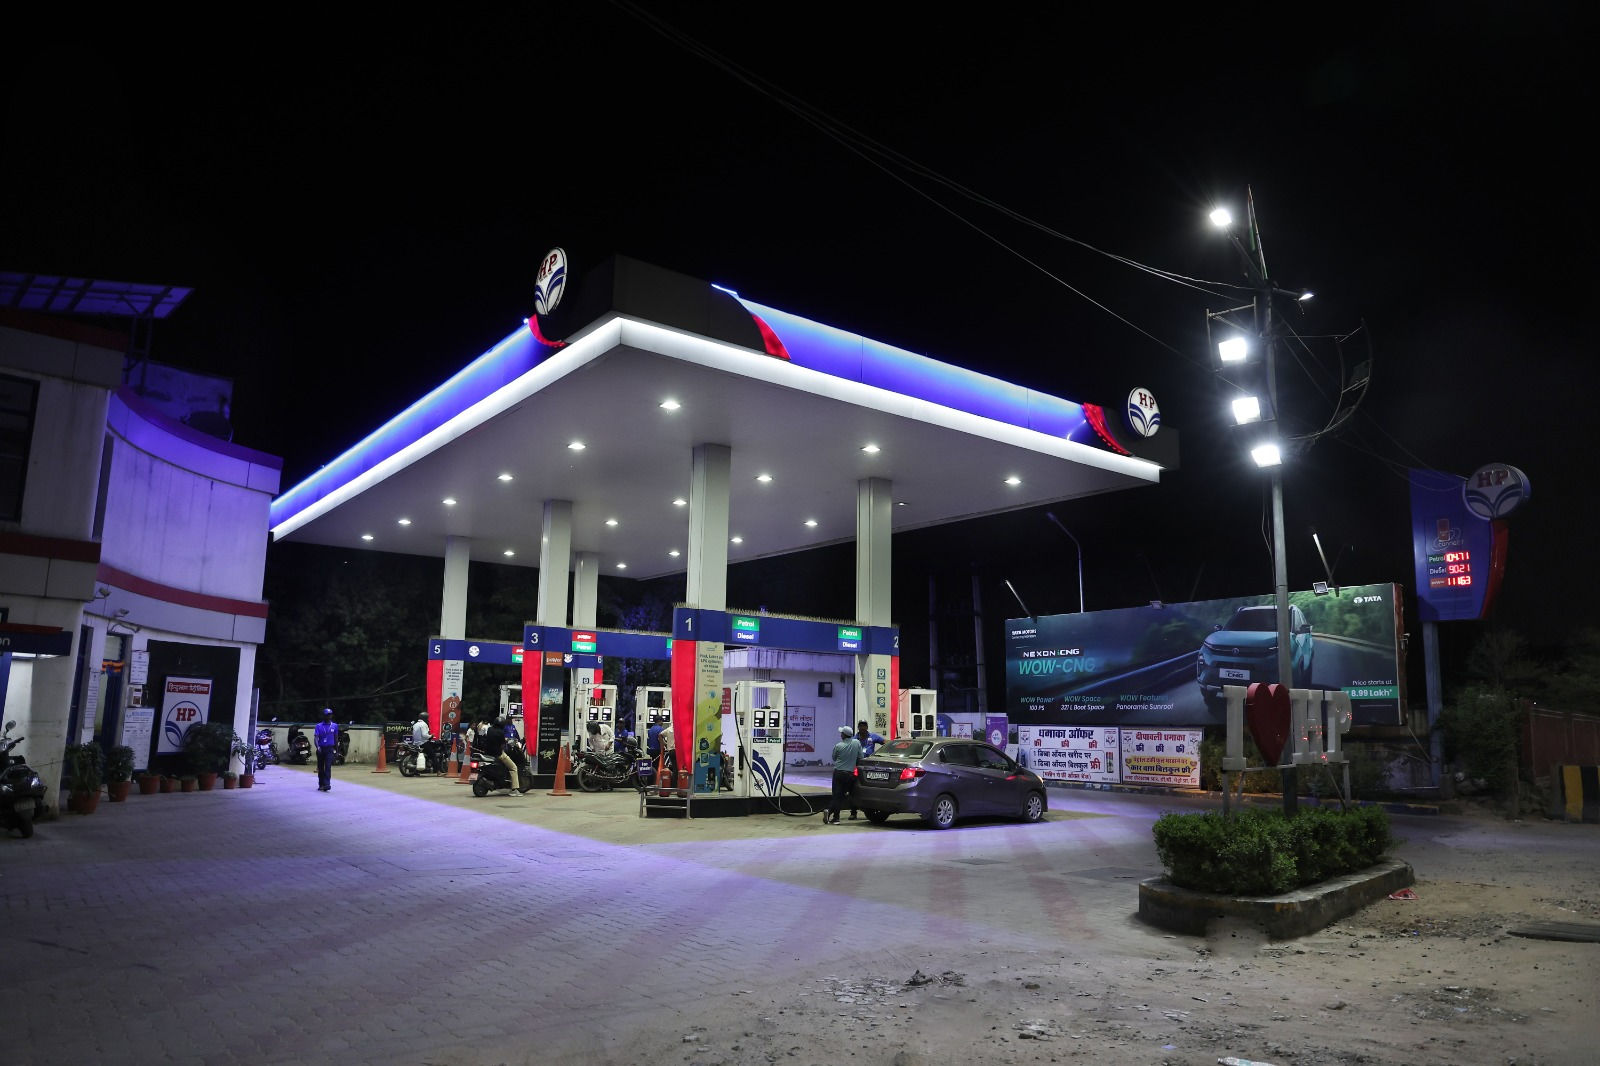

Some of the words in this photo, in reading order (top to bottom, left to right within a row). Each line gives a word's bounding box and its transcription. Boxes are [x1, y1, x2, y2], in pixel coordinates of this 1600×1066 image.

[538, 253, 557, 280] HP
[1138, 391, 1155, 409] HP
[1477, 469, 1509, 488] HP
[1363, 595, 1382, 603] TATA
[685, 617, 692, 632] 1
[737, 619, 755, 627] Petrol
[530, 632, 539, 644] 3
[737, 632, 755, 640] Diesel
[842, 629, 858, 637] Petrol
[842, 641, 858, 649] Diesel
[893, 636, 899, 649] 2
[433, 644, 441, 655] 5
[1023, 650, 1056, 658] NEXON
[597, 655, 603, 664] 6
[1018, 657, 1097, 676] WOW-CNG
[1367, 678, 1385, 686] starts
[1081, 695, 1101, 703] Space
[1120, 694, 1138, 702] WOW
[1087, 704, 1105, 712] Space
[176, 708, 197, 722] HP
[1222, 684, 1248, 771] I
[1289, 688, 1353, 765] HP
[1038, 728, 1066, 739] धमाका
[1068, 727, 1094, 740] ऑफर
[1135, 731, 1163, 742] दीपावली
[1164, 733, 1187, 742] धमाका
[1089, 757, 1101, 770] फ्री
